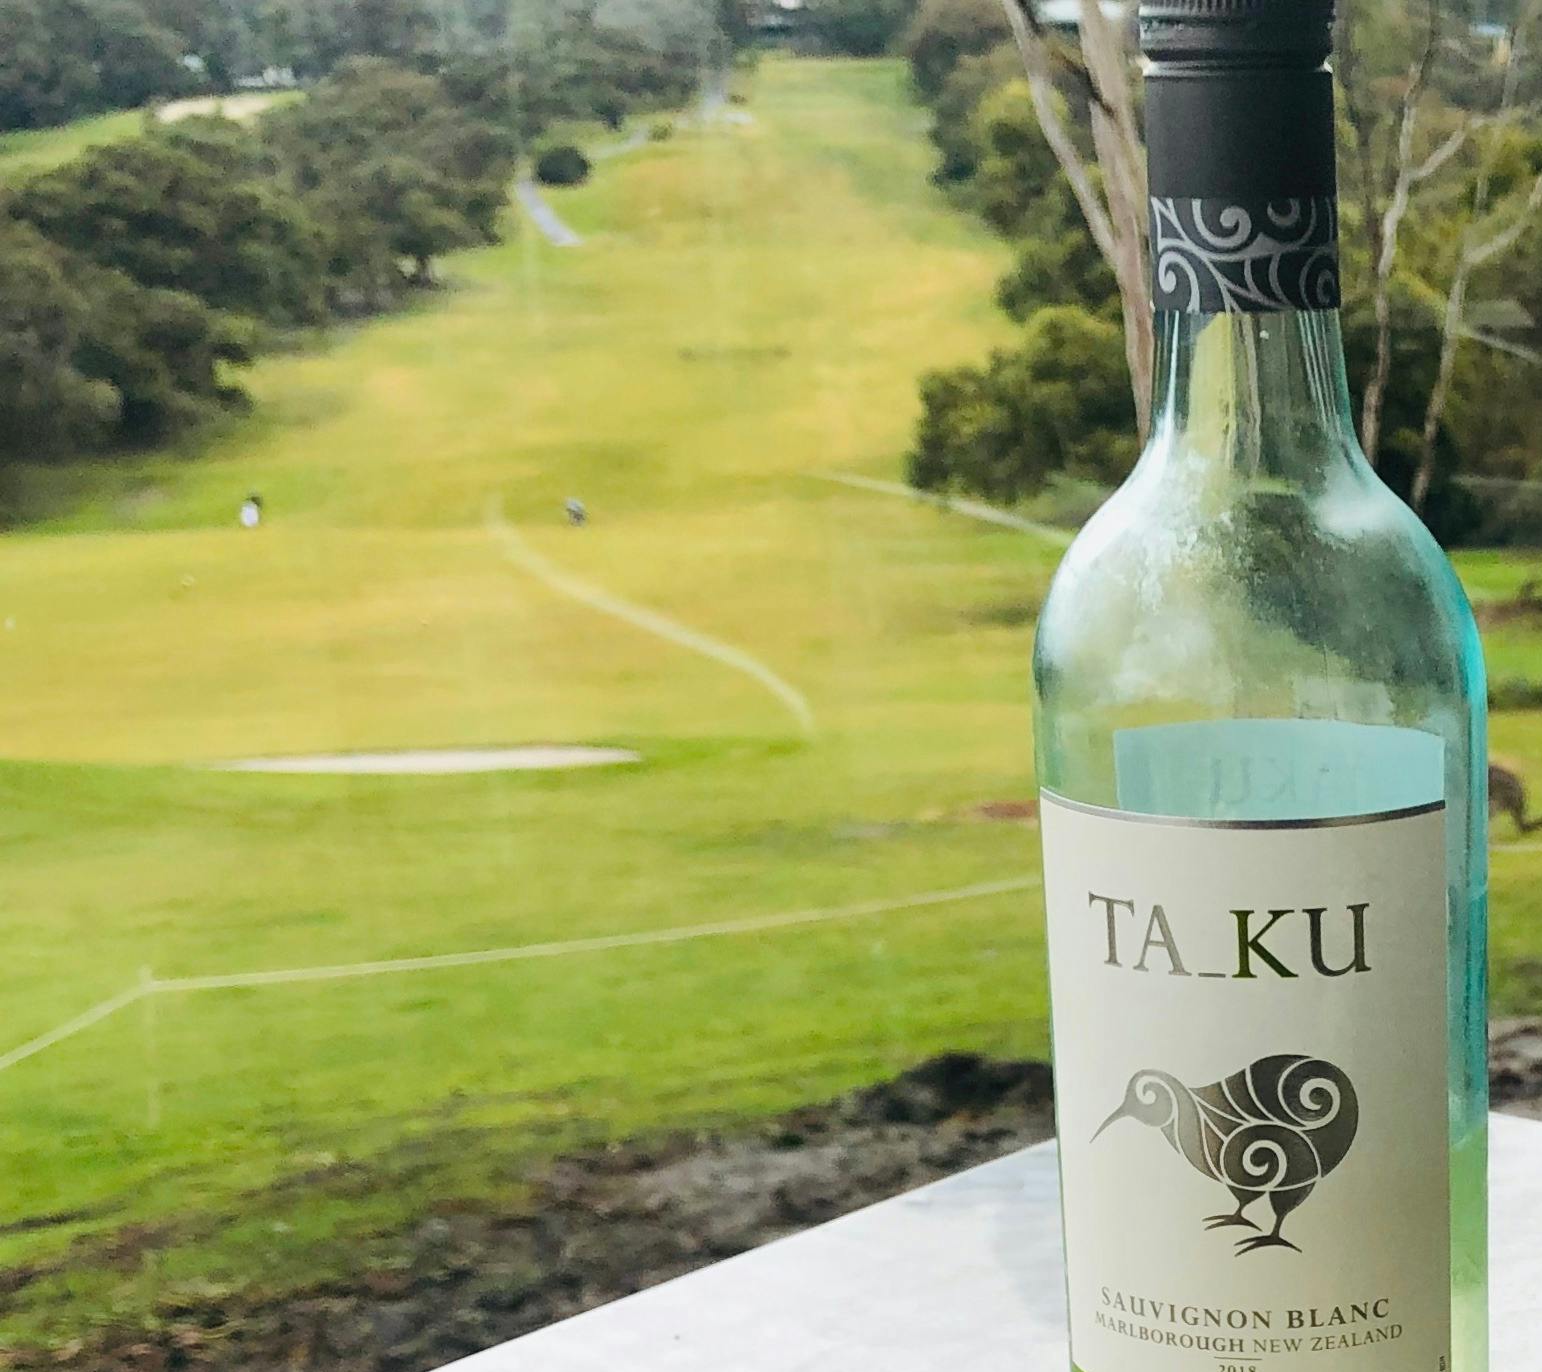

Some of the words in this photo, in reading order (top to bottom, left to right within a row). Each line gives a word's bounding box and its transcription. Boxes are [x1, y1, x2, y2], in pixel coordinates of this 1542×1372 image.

[1088, 891, 1372, 979] TA_KU
[1101, 1286, 1272, 1330] SAUVIGNON
[1287, 1298, 1390, 1329] BLANC
[1095, 1311, 1245, 1353] MARLBOROUGH
[1253, 1338, 1303, 1354] NEW
[1311, 1324, 1403, 1351] ZEALAND
